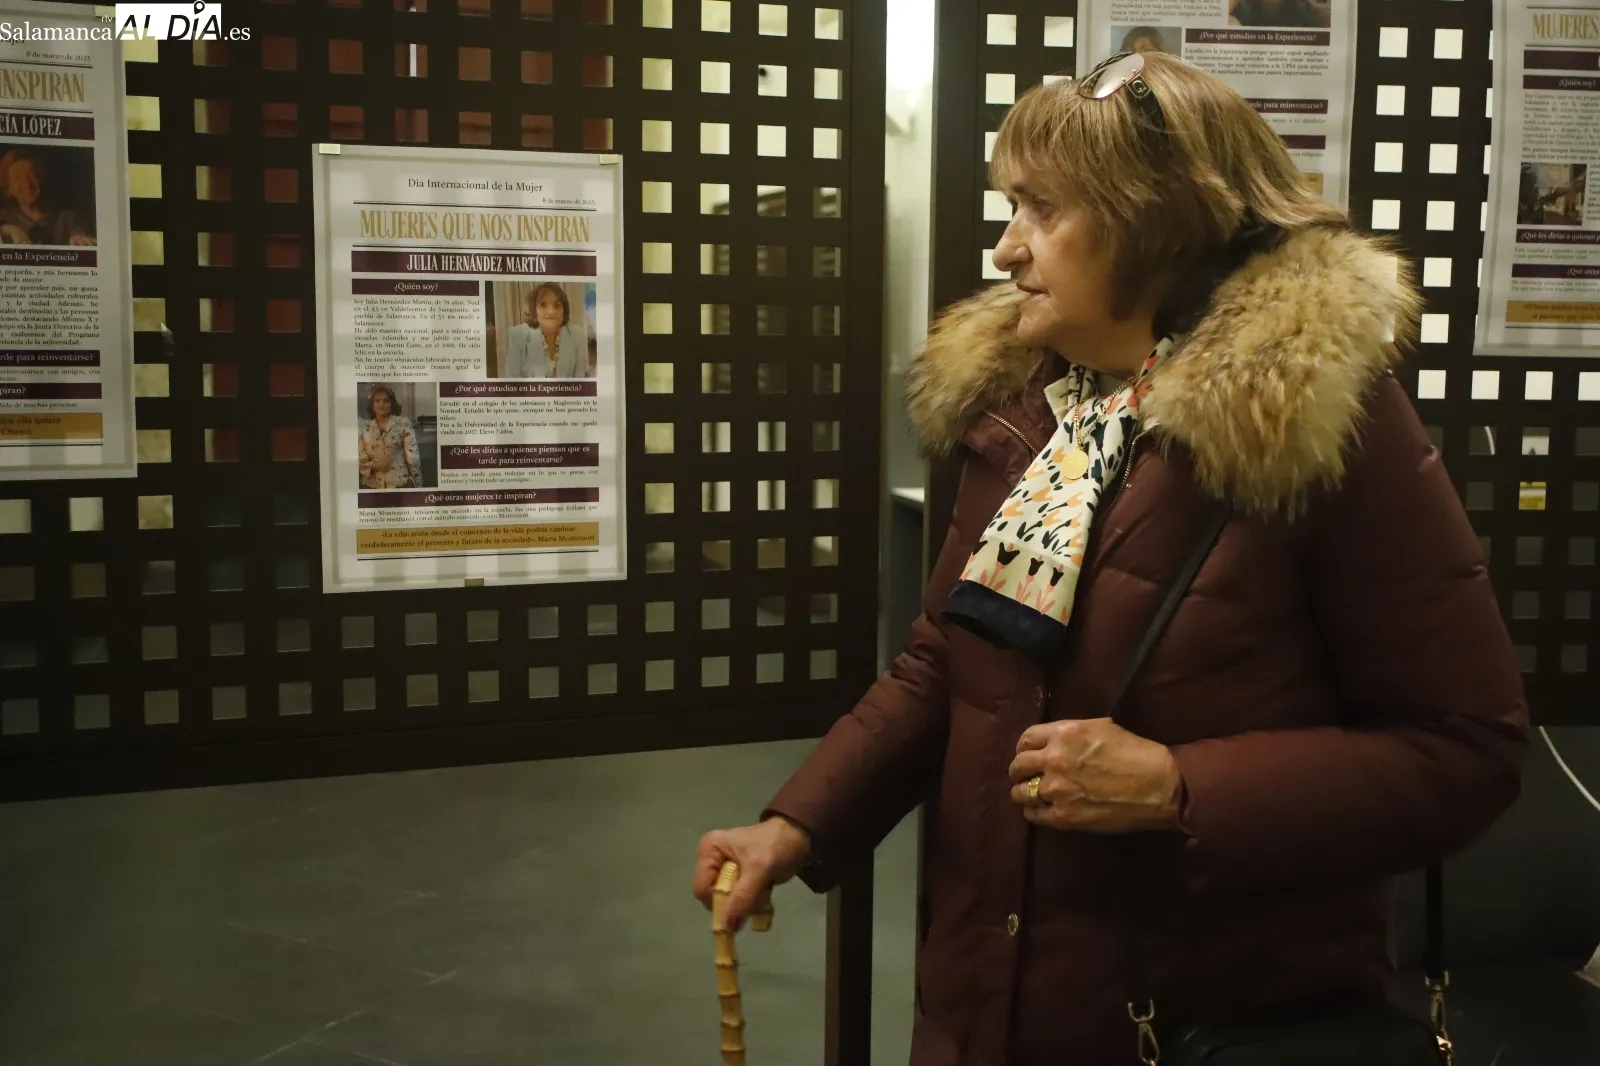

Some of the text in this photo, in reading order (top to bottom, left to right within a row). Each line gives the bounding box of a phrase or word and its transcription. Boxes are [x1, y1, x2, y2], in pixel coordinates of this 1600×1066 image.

[1533, 14, 1599, 39] MUJERES
[1275, 33, 1316, 42] Experiencia?
[0, 69, 84, 102] NSPIRAN
[22, 115, 61, 136] LÓPEZ
[427, 179, 489, 190] Internacional
[492, 181, 502, 190] de
[505, 182, 513, 190] la
[516, 182, 543, 193] Mujer
[360, 210, 590, 243] MUJERES QUE NOS INSPIRAN
[25, 252, 79, 262] Experiencia?
[407, 253, 546, 272] JULIA HERNÁNDEZ MARTÍN
[395, 282, 438, 292] ¿Quién soy?
[455, 385, 472, 394] ¿Por
[450, 447, 469, 456] ¿Qué
[539, 446, 566, 455] piensan
[424, 494, 443, 504] ¿Qué
[465, 493, 493, 502] mujeres
[504, 492, 537, 500] inspiran?
[526, 526, 547, 534] podría
